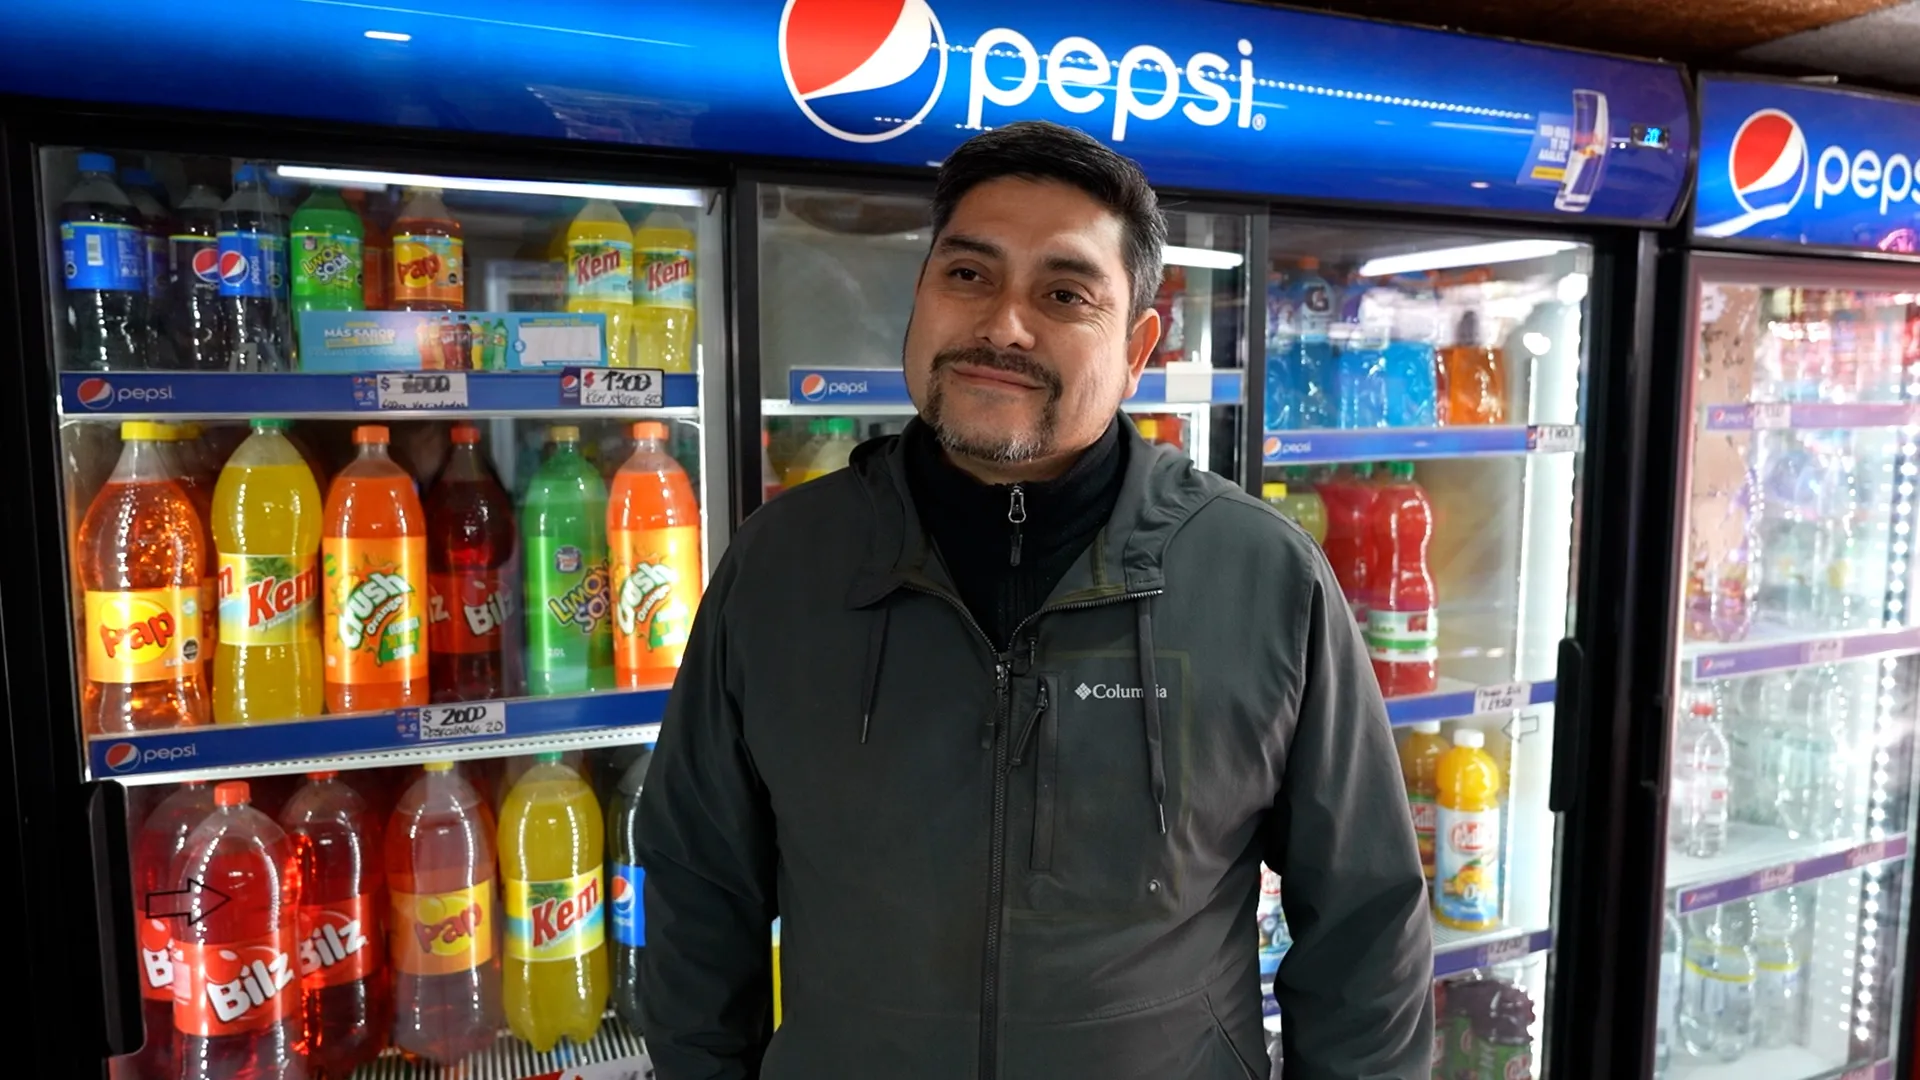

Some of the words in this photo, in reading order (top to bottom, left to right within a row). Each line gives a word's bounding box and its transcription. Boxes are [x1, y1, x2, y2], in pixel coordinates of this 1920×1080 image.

[966, 27, 1254, 142] pepsi
[397, 254, 440, 286] Pap
[576, 249, 621, 286] Kem
[647, 256, 690, 291] Kem
[117, 385, 173, 402] pepsi
[828, 380, 868, 396] pepsi
[1282, 439, 1312, 454] pepsi
[247, 564, 317, 628] Kem
[100, 611, 176, 659] Pap
[1092, 683, 1168, 699] Columia
[422, 709, 433, 724] $
[440, 705, 487, 727] 2000
[143, 743, 196, 764] pepsi
[414, 902, 483, 953] Pap
[532, 877, 599, 948] Kem
[301, 918, 370, 976] Bilz
[206, 952, 295, 1023] Bilz
